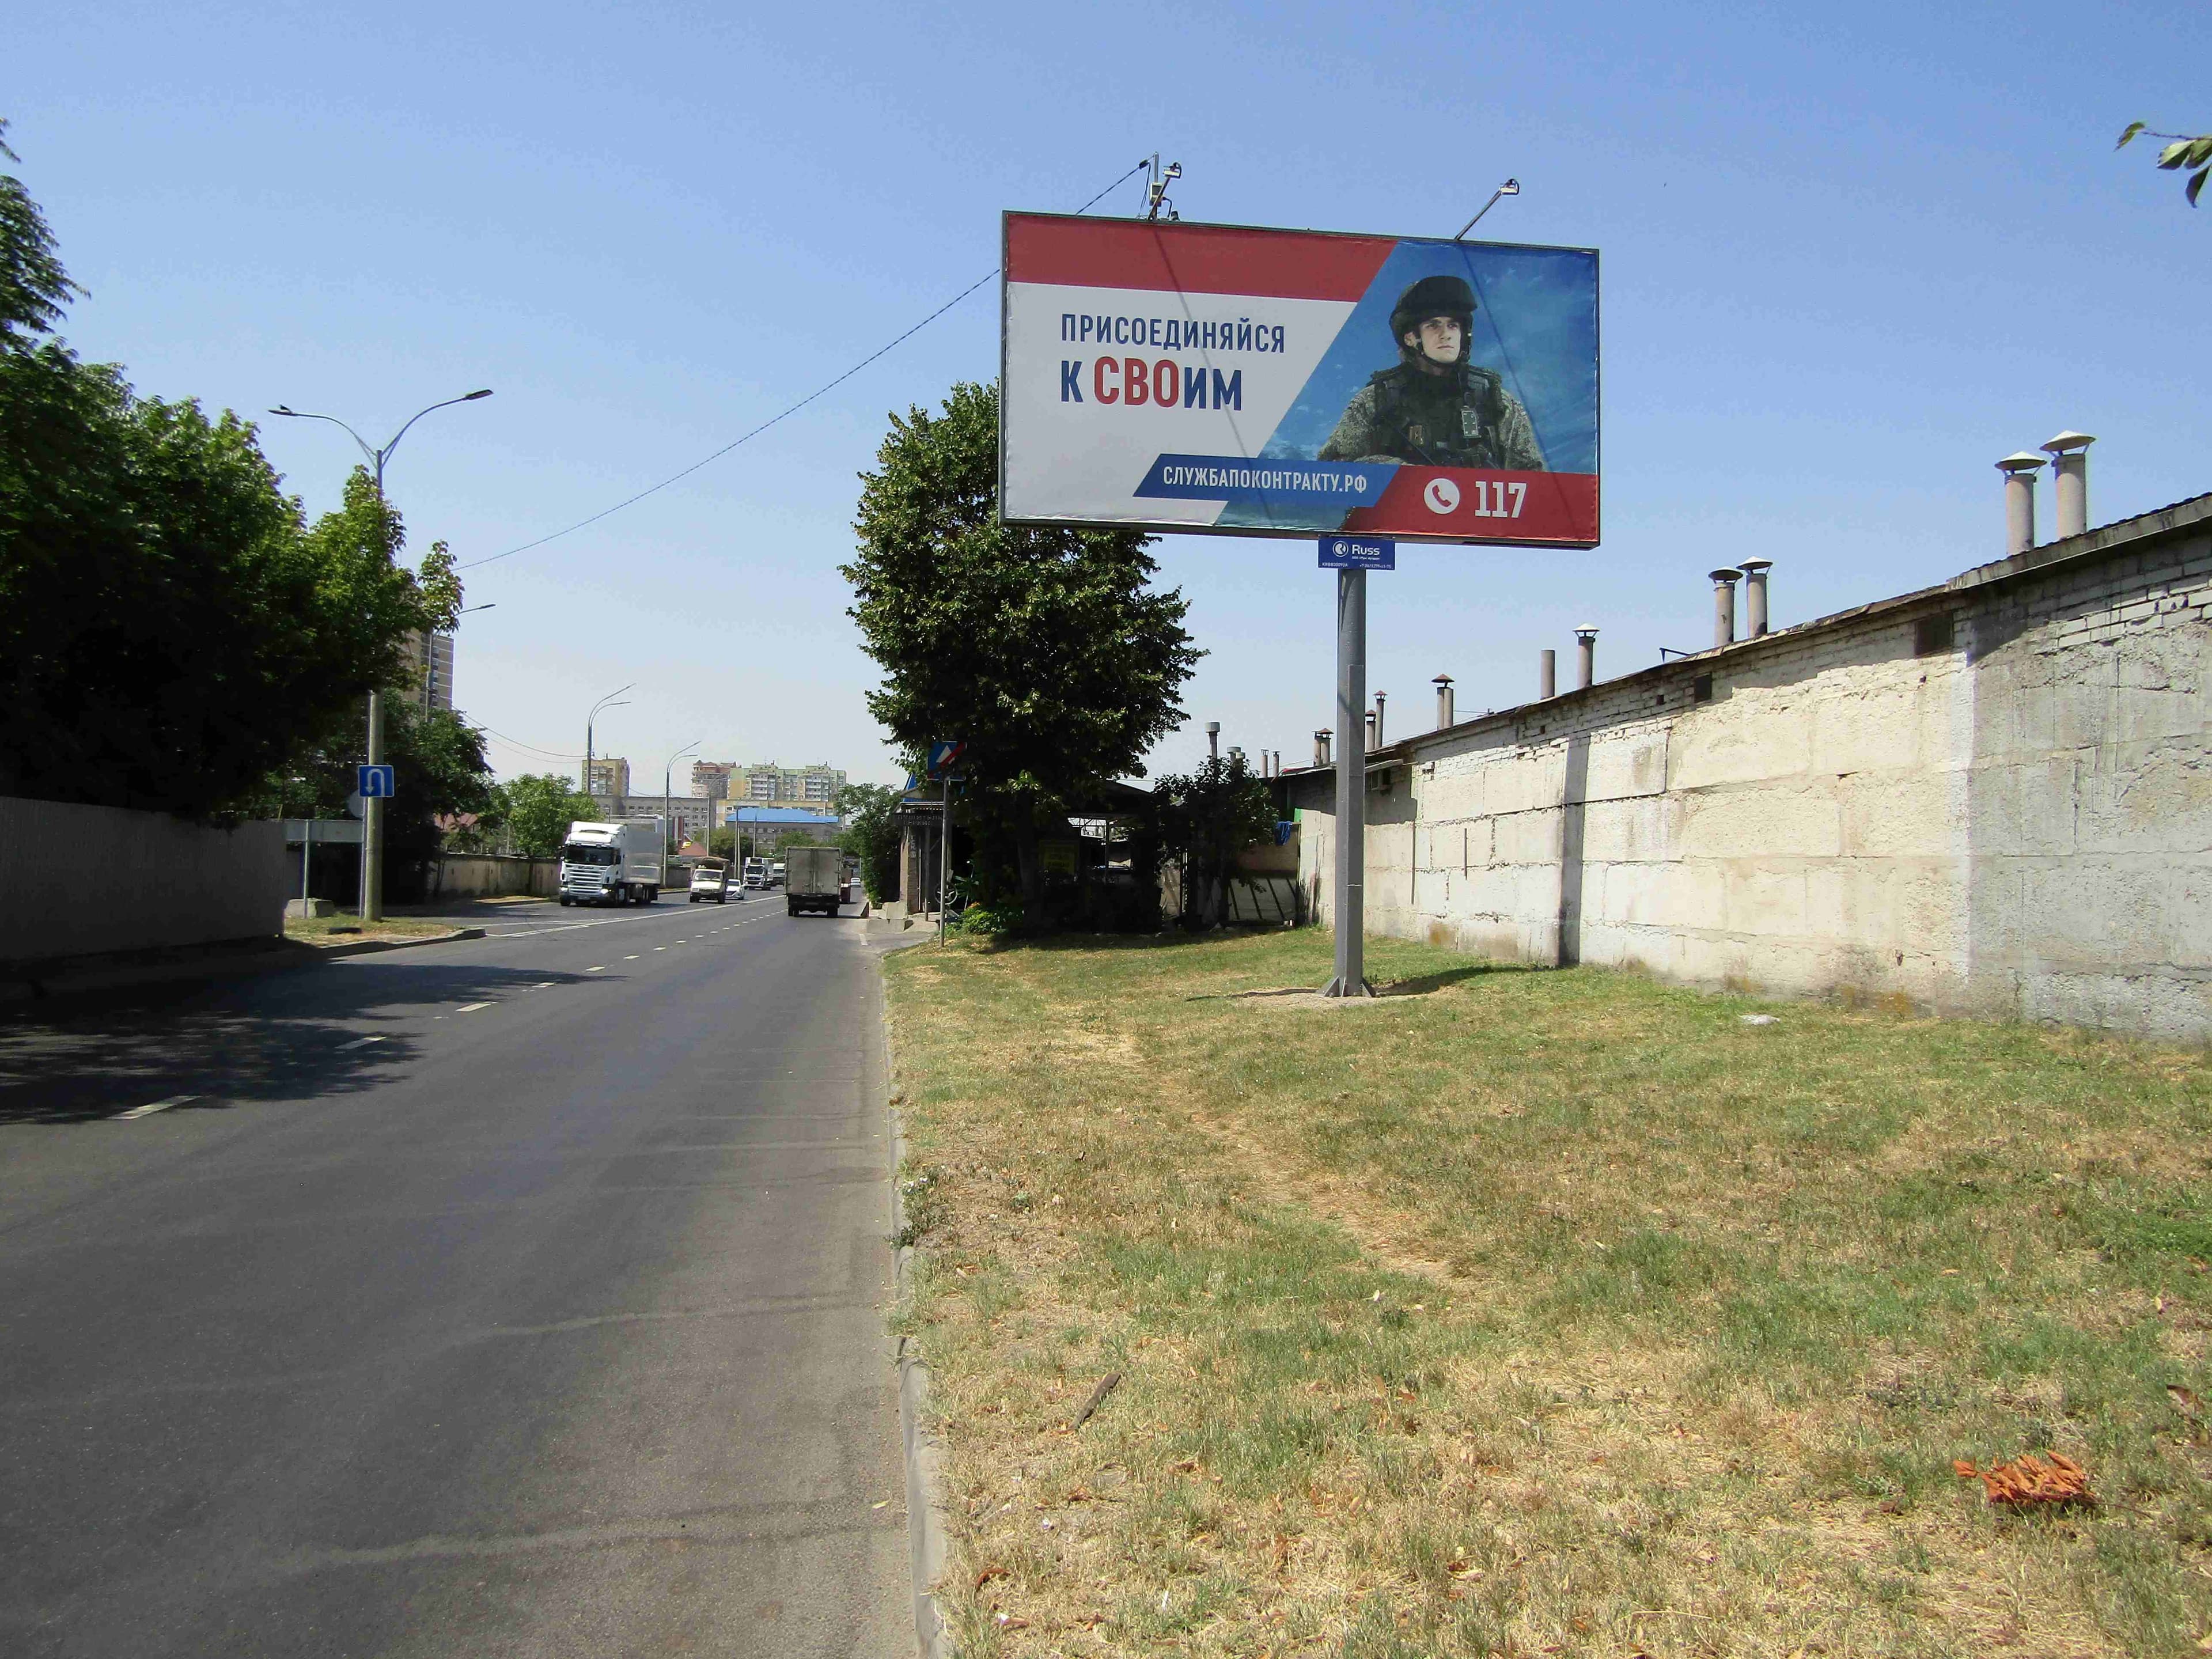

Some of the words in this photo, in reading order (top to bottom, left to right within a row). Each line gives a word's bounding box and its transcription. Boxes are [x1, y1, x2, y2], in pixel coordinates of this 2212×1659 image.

[1062, 313, 1285, 353] ПРИСОЕДИНЯЙСЯ
[1060, 360, 1084, 403] К
[1163, 466, 1368, 493] СЛУЖБАПОКОНТРАКТУ.РФ
[1475, 480, 1527, 518] 117
[1351, 544, 1380, 555] Russ
